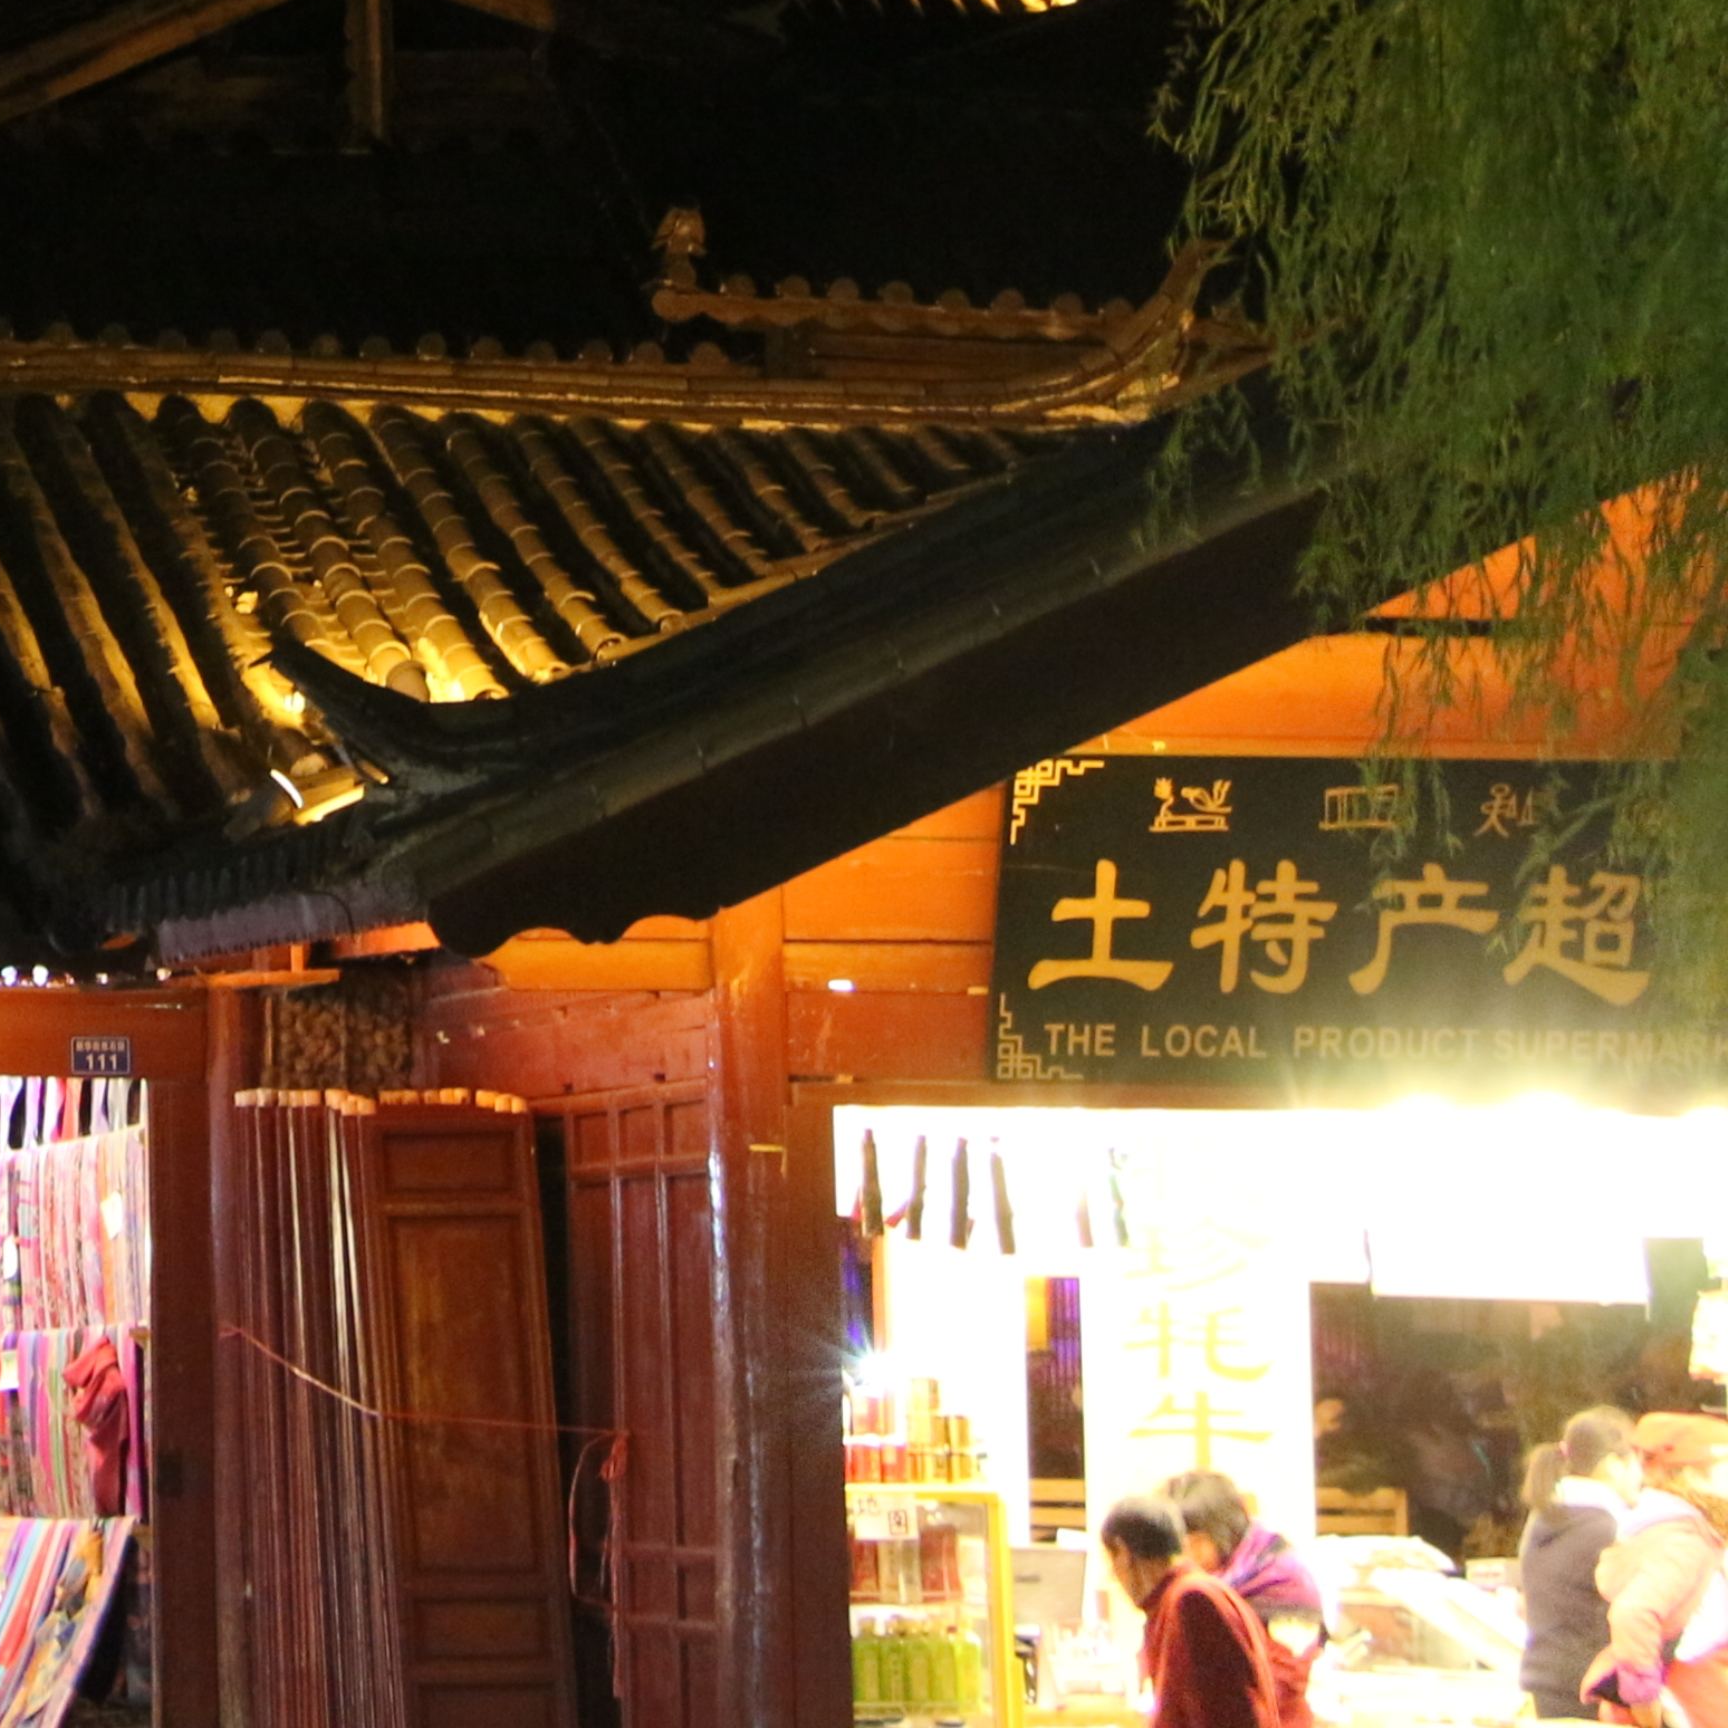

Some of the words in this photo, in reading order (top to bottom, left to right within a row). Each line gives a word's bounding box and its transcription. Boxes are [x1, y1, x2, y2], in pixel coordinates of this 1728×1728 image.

[1028, 858, 1650, 1007] 土特产超
[85, 1053, 117, 1070] 111
[1045, 1024, 1115, 1057] THE
[1142, 1025, 1266, 1059] LOCAL
[1293, 1027, 1480, 1062] PRODUCT
